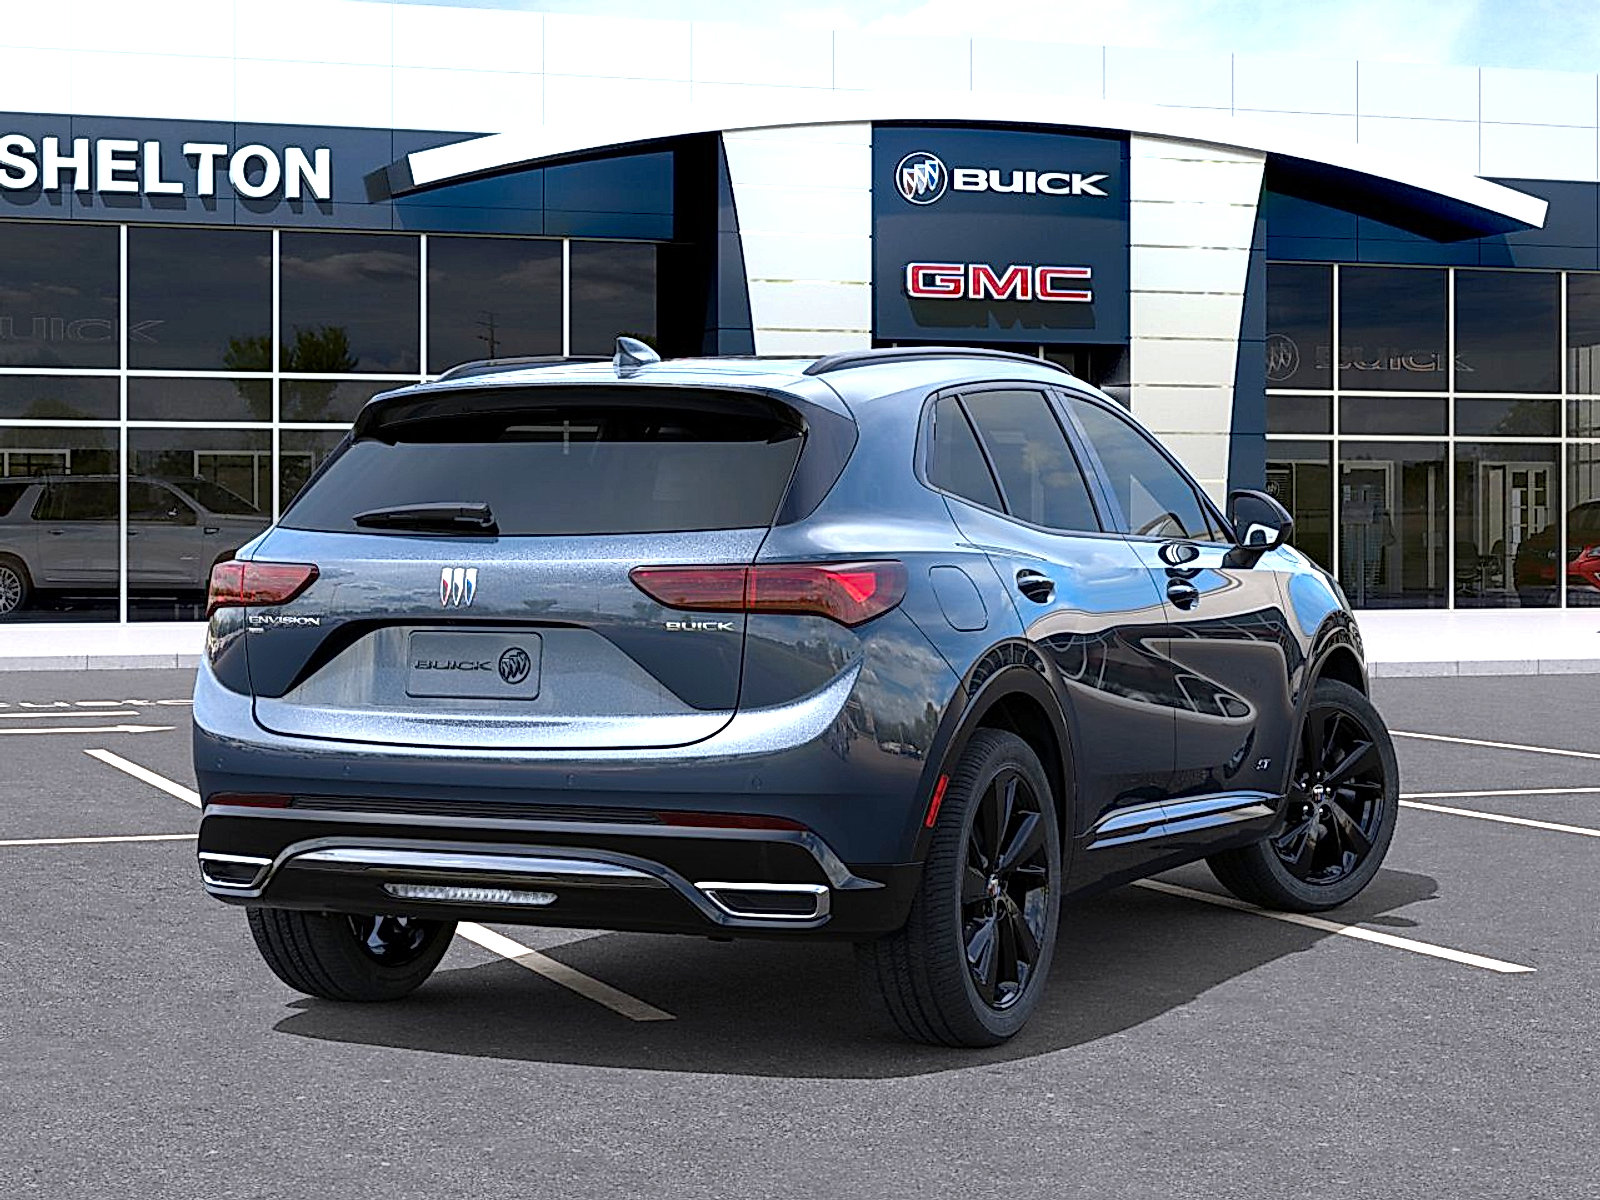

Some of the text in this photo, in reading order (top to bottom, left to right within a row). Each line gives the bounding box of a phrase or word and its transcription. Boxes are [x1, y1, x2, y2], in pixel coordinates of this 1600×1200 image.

[0, 134, 331, 200] SHELTON
[953, 168, 1110, 197] BUICK
[906, 262, 1092, 303] GMC
[248, 615, 320, 627] ENVISION
[665, 621, 735, 632] BUICK
[414, 660, 493, 671] BUICK
